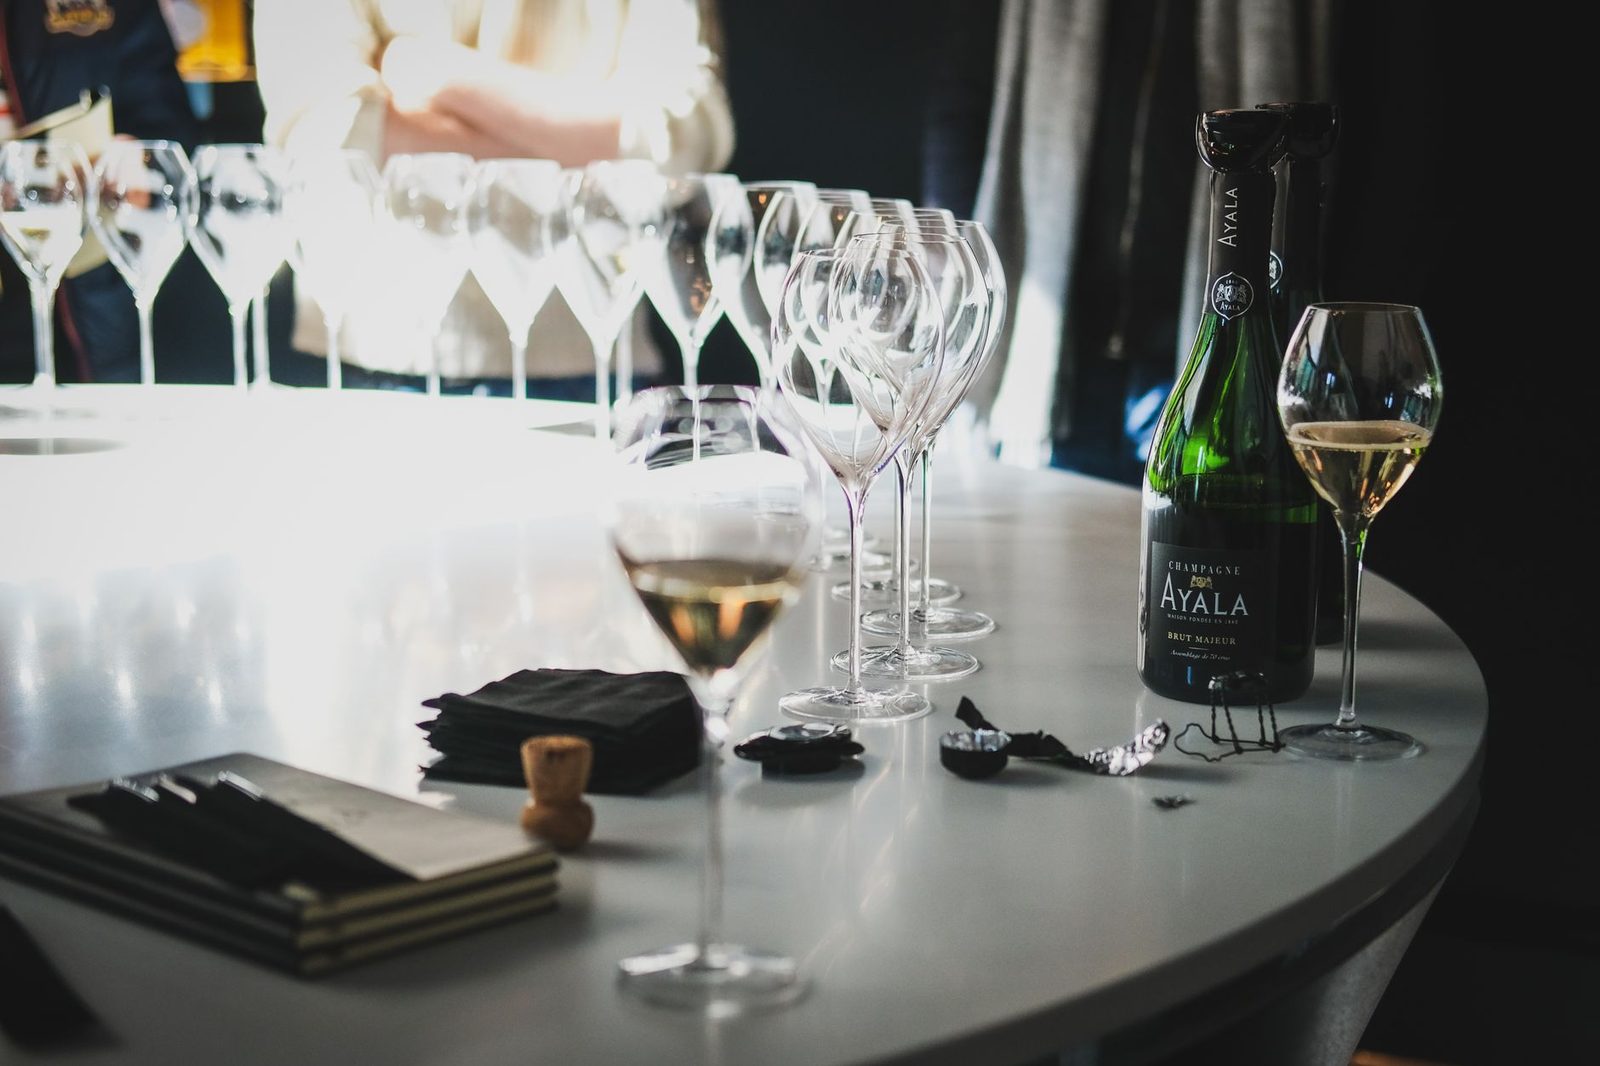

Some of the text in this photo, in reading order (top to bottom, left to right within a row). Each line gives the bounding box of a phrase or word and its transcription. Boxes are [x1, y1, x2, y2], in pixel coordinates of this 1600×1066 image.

[1217, 187, 1238, 247] AYALA
[1220, 301, 1241, 311] AYALA
[1168, 560, 1241, 576] CHAMPAGNE
[1160, 571, 1249, 616] AYALA
[1167, 631, 1237, 645] BRUT MAJEUR
